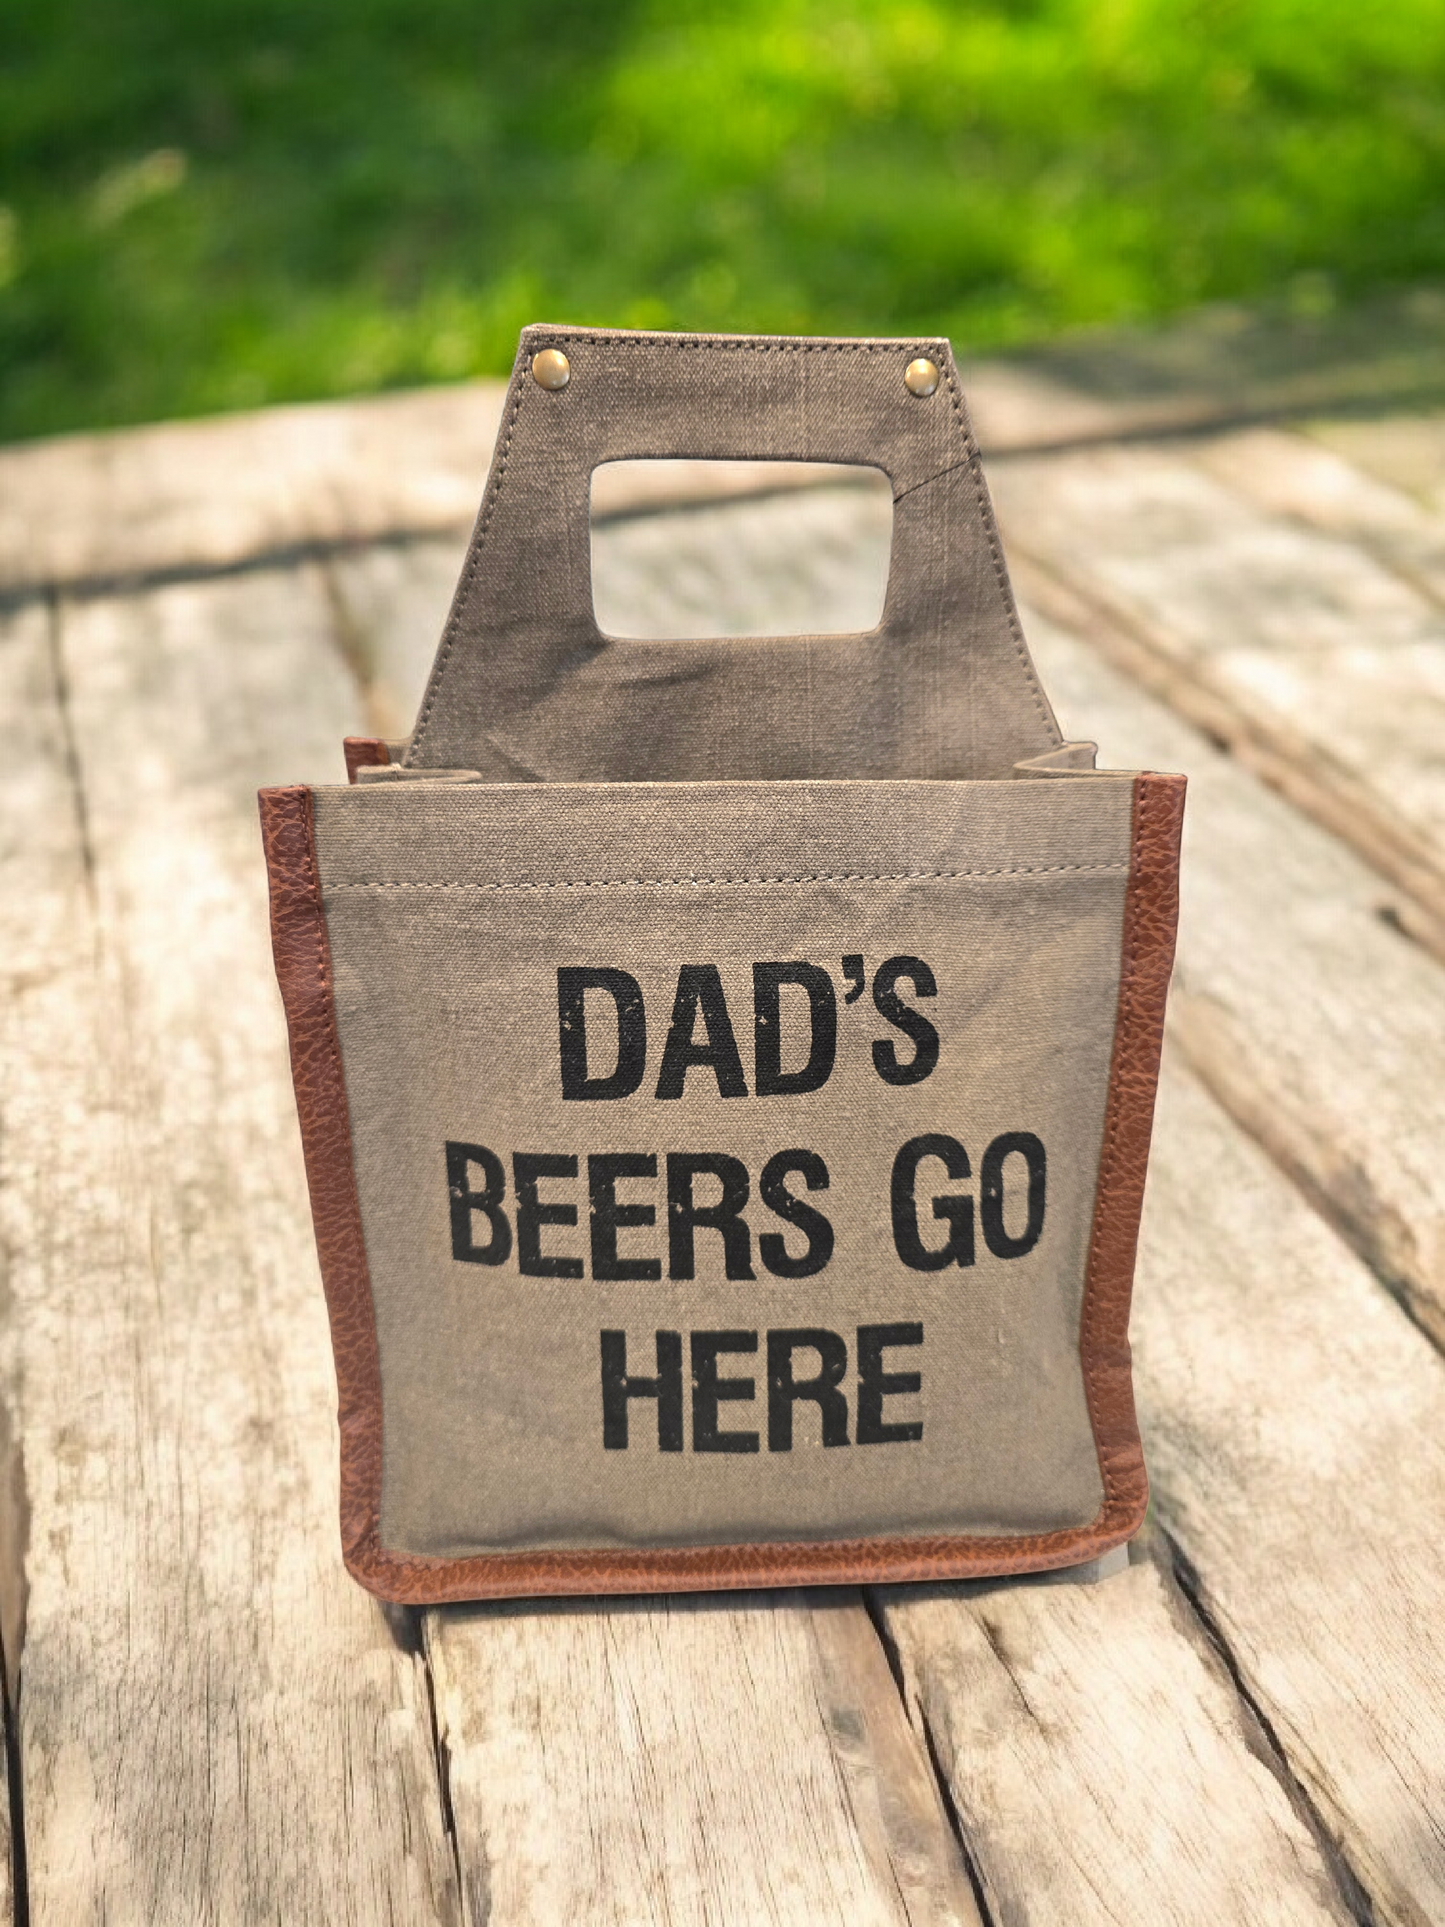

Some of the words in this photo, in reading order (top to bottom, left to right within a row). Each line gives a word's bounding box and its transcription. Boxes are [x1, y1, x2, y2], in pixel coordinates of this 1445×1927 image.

[557, 954, 939, 1101] DAD'S
[446, 1141, 834, 1281] BEERS
[891, 1132, 1046, 1272] GO
[601, 1323, 923, 1453] HERE
